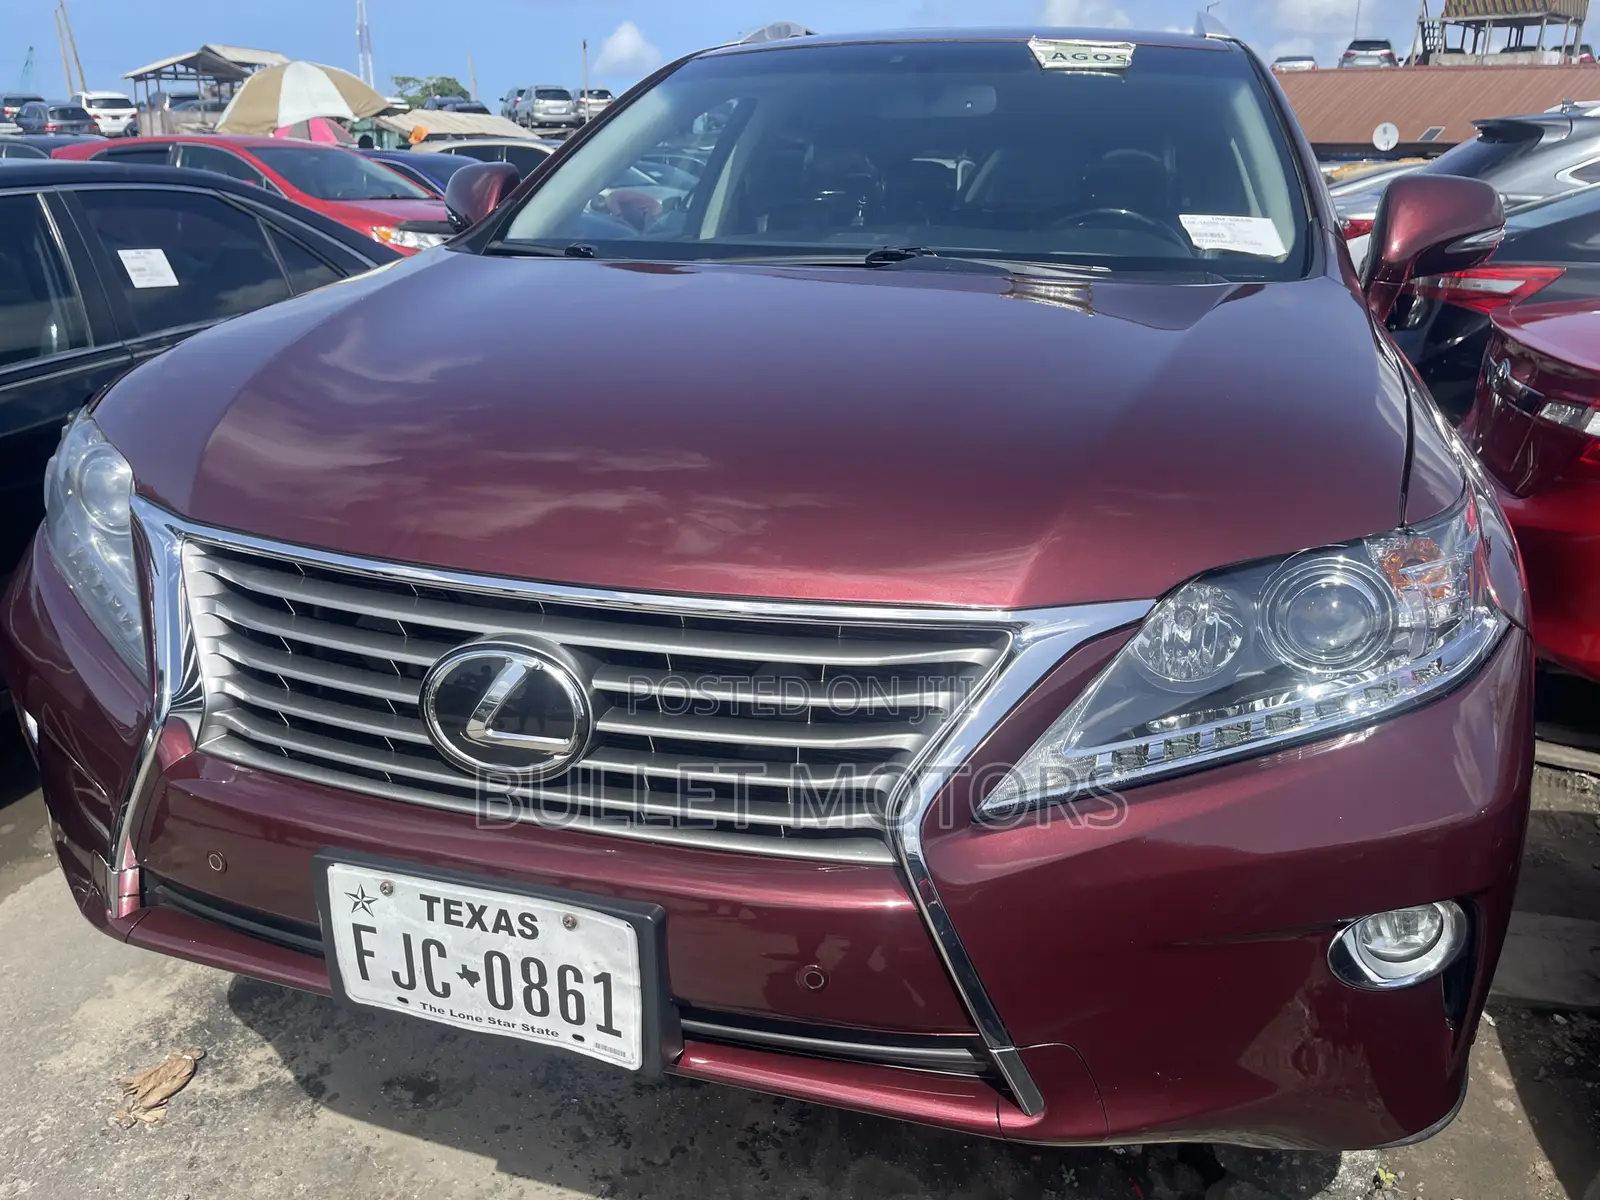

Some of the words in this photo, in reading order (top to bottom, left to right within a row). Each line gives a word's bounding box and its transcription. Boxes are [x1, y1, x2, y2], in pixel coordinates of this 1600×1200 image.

[419, 893, 540, 940] TEXAS
[352, 922, 452, 999] FJC
[483, 949, 623, 1038] 0861
[420, 1001, 446, 1015] The
[449, 1008, 484, 1023] Lone
[487, 1015, 518, 1030] Star
[521, 1022, 560, 1038] State
